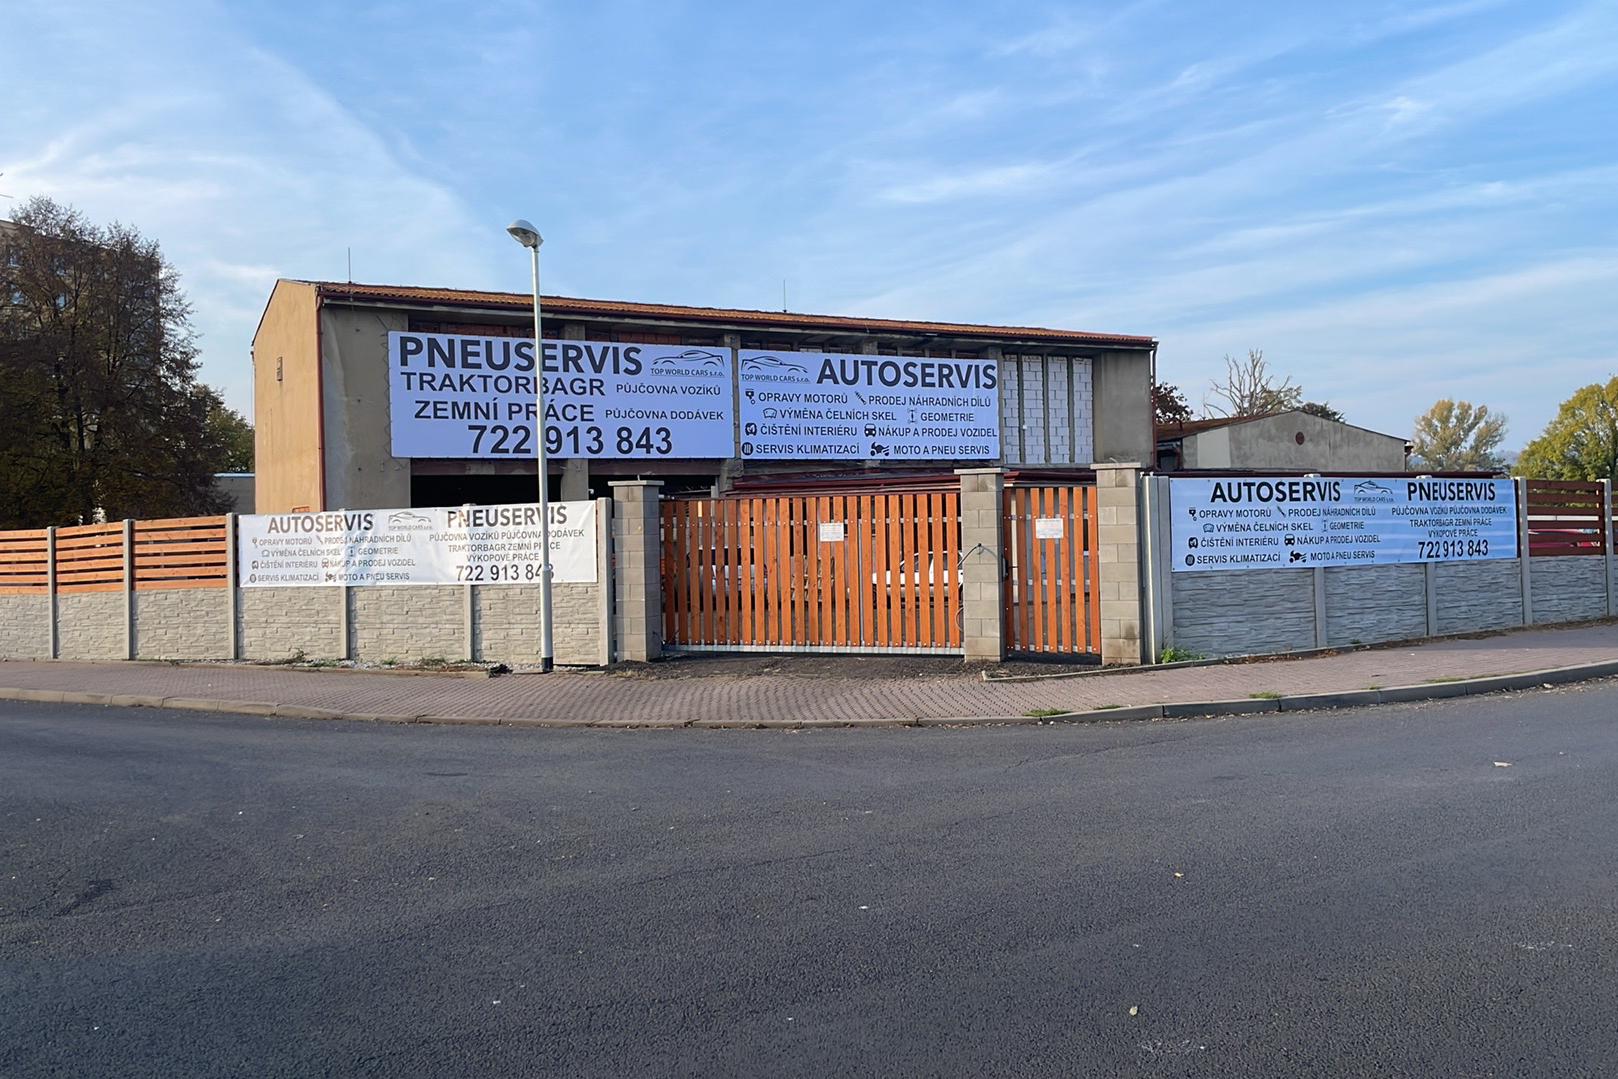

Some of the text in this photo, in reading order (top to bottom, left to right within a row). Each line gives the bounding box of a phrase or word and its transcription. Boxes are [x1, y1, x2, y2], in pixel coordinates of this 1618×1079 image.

[399, 335, 643, 376] PNEUSERVIS
[665, 368, 689, 376] WORLD
[691, 369, 708, 377] CARS
[816, 358, 997, 390] AUTOSERVIS
[400, 371, 606, 396] TRAKTORBAGR
[616, 382, 721, 395] PŮJČOVNA VOZÍKŮ
[758, 392, 848, 404] OPRAVY MOTORŮ
[868, 394, 991, 407] PRODEJ NÁHRADNÍCH DÍLŮ
[414, 397, 595, 422] ZEMNÍ PRÁCE
[605, 407, 724, 420] PŮJČOVNA DODÁVEK
[779, 407, 897, 421] VÝMĚNA ČELNÍCH SKEL
[920, 412, 975, 422] GEOMETRIE
[760, 424, 857, 436] ČIŠTĚNÍ INTERIÉRU
[878, 425, 997, 437] NÁKUP A PRODEJ VOZIDEL
[468, 425, 672, 454] 722 913 843
[755, 443, 860, 454] SERVIS KLIMATIZACÍ
[894, 445, 990, 455] MOTO A PNEU SERVIS
[1210, 481, 1341, 503] AUTOSERVIS
[1407, 481, 1496, 501] PNEUSERVIS
[1199, 507, 1272, 518] OPRAVY MOTORŮ
[1288, 505, 1376, 517] PRODEJ NÁHRADNÍCH DÍLŮ
[1391, 505, 1429, 516] PŮJČOVNA
[1449, 505, 1480, 515] PŮJČOVNA
[1481, 505, 1507, 515] DODÁVEK
[268, 513, 374, 533] AUTOSERVIS
[1216, 521, 1314, 532] VÝMĚNA ČELNÍCH SKEL
[1329, 521, 1364, 530] GEOMETRIE
[1410, 517, 1492, 527] TRAKTORBAGR ZEMNÍ PRÁCE
[396, 533, 411, 542] DÍLŮ
[429, 528, 584, 541] PŮJČOVNA VOZÍKŮ PŮJČOVNA ODÁVEK
[1428, 527, 1478, 538] VÝKOPOVÉ PRÁCE
[259, 537, 312, 546] OPRAVY MOTORŮ
[1200, 535, 1279, 547] ČIŠTĚNÍ INTERIÉRU
[1296, 534, 1381, 545] NÁKUP A PRODEJ VOZIDEL
[270, 549, 297, 557] VÝMĚNA
[298, 548, 325, 557] ČELNÍCH
[357, 547, 398, 555] GEOMETRIE
[448, 541, 561, 553] TRAKTORBAGR ZEMNÍ PCE
[1418, 539, 1489, 559] 722 913 843
[466, 552, 540, 562] VÝKOPOVÉ PRÁCE
[1197, 552, 1280, 564] SERVIS KLIMATIZACÍ
[1310, 552, 1330, 561] MOTO
[1335, 552, 1351, 560] PNEU
[1353, 551, 1375, 559] SERVIS
[260, 559, 317, 569] ČIŠTĚNÍ INTERIÉRU
[358, 559, 386, 567] PRODEJ
[387, 558, 415, 567] VOZIDEL
[257, 573, 319, 582] SERVIS KLIMATIZACÍ
[456, 565, 484, 581] 722
[490, 564, 519, 581] 913
